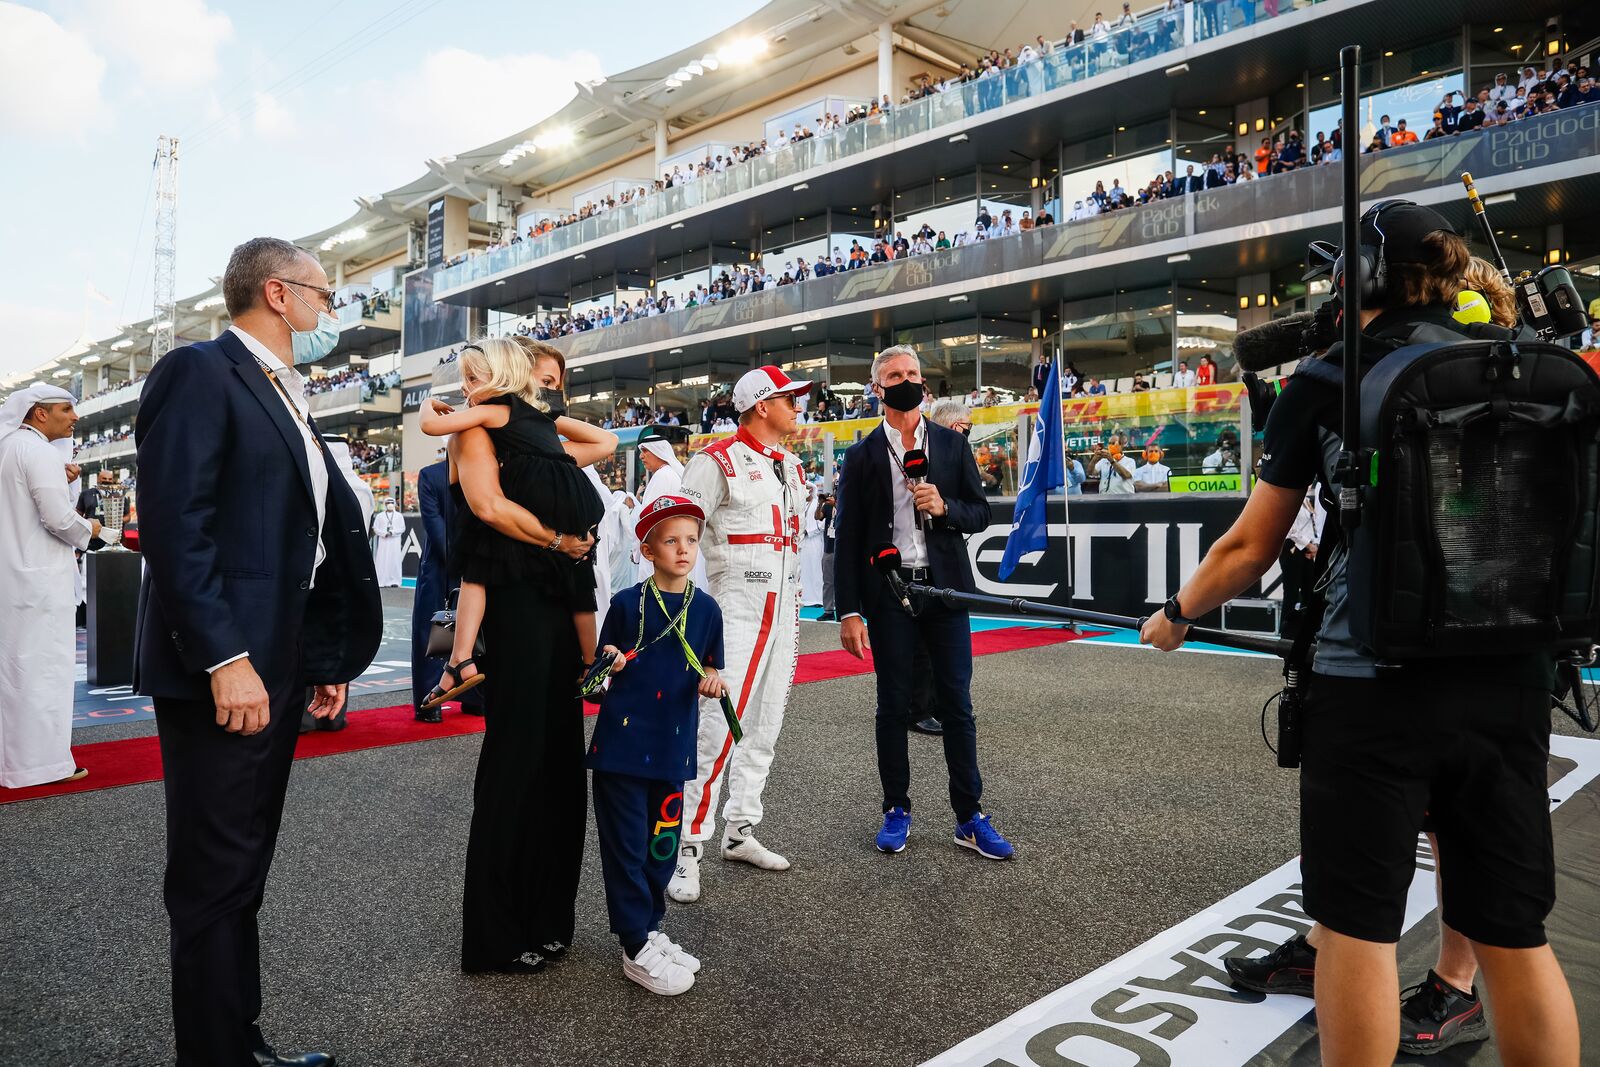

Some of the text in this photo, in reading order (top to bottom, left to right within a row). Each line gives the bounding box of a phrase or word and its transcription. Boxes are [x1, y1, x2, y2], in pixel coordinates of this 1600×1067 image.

[1492, 140, 1549, 168] Club
[1142, 196, 1217, 224] Paddck
[1142, 219, 1179, 239] Club
[906, 251, 960, 274] Paddock
[906, 271, 932, 287] Club
[744, 570, 772, 580] sparco
[967, 523, 1203, 604] ETI
